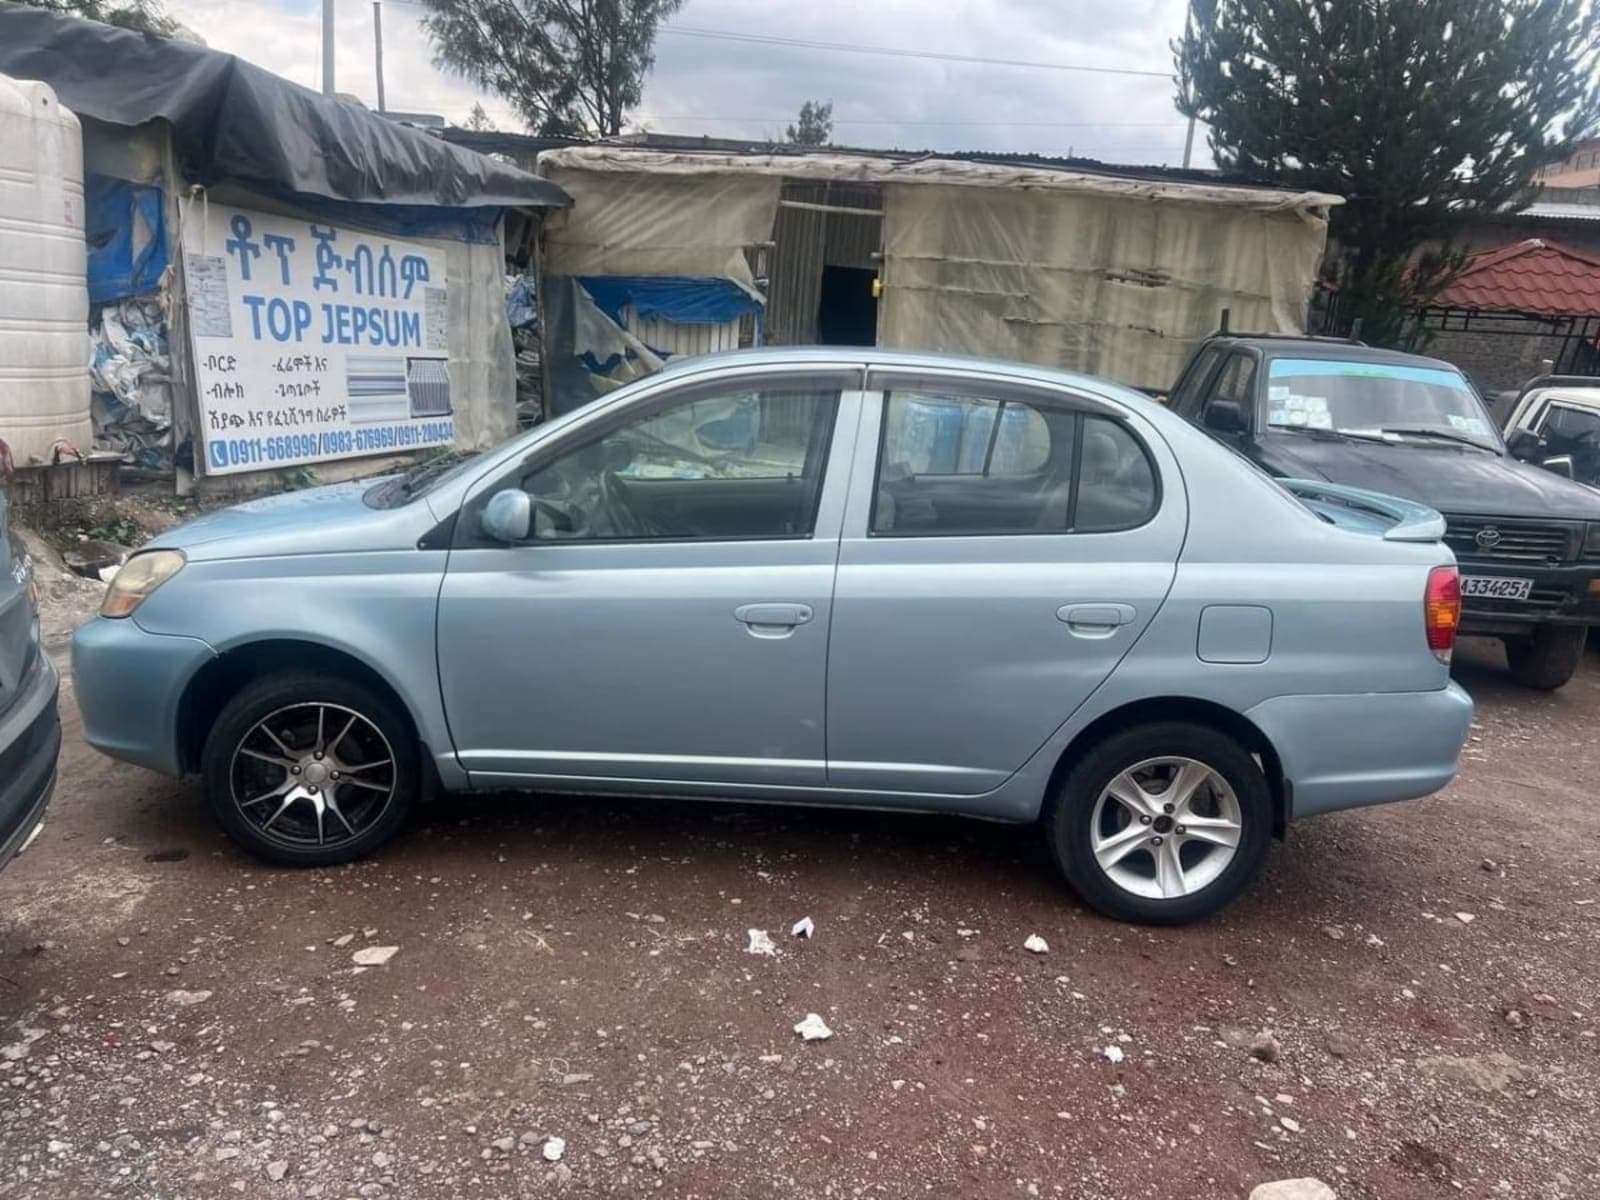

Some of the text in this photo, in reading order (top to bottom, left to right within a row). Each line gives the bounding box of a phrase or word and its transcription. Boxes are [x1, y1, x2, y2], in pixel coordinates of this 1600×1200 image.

[226, 214, 296, 286] ቶፕ
[243, 295, 421, 347] TOP JEPSUM
[314, 356, 328, 371] እና
[247, 409, 264, 428] እና
